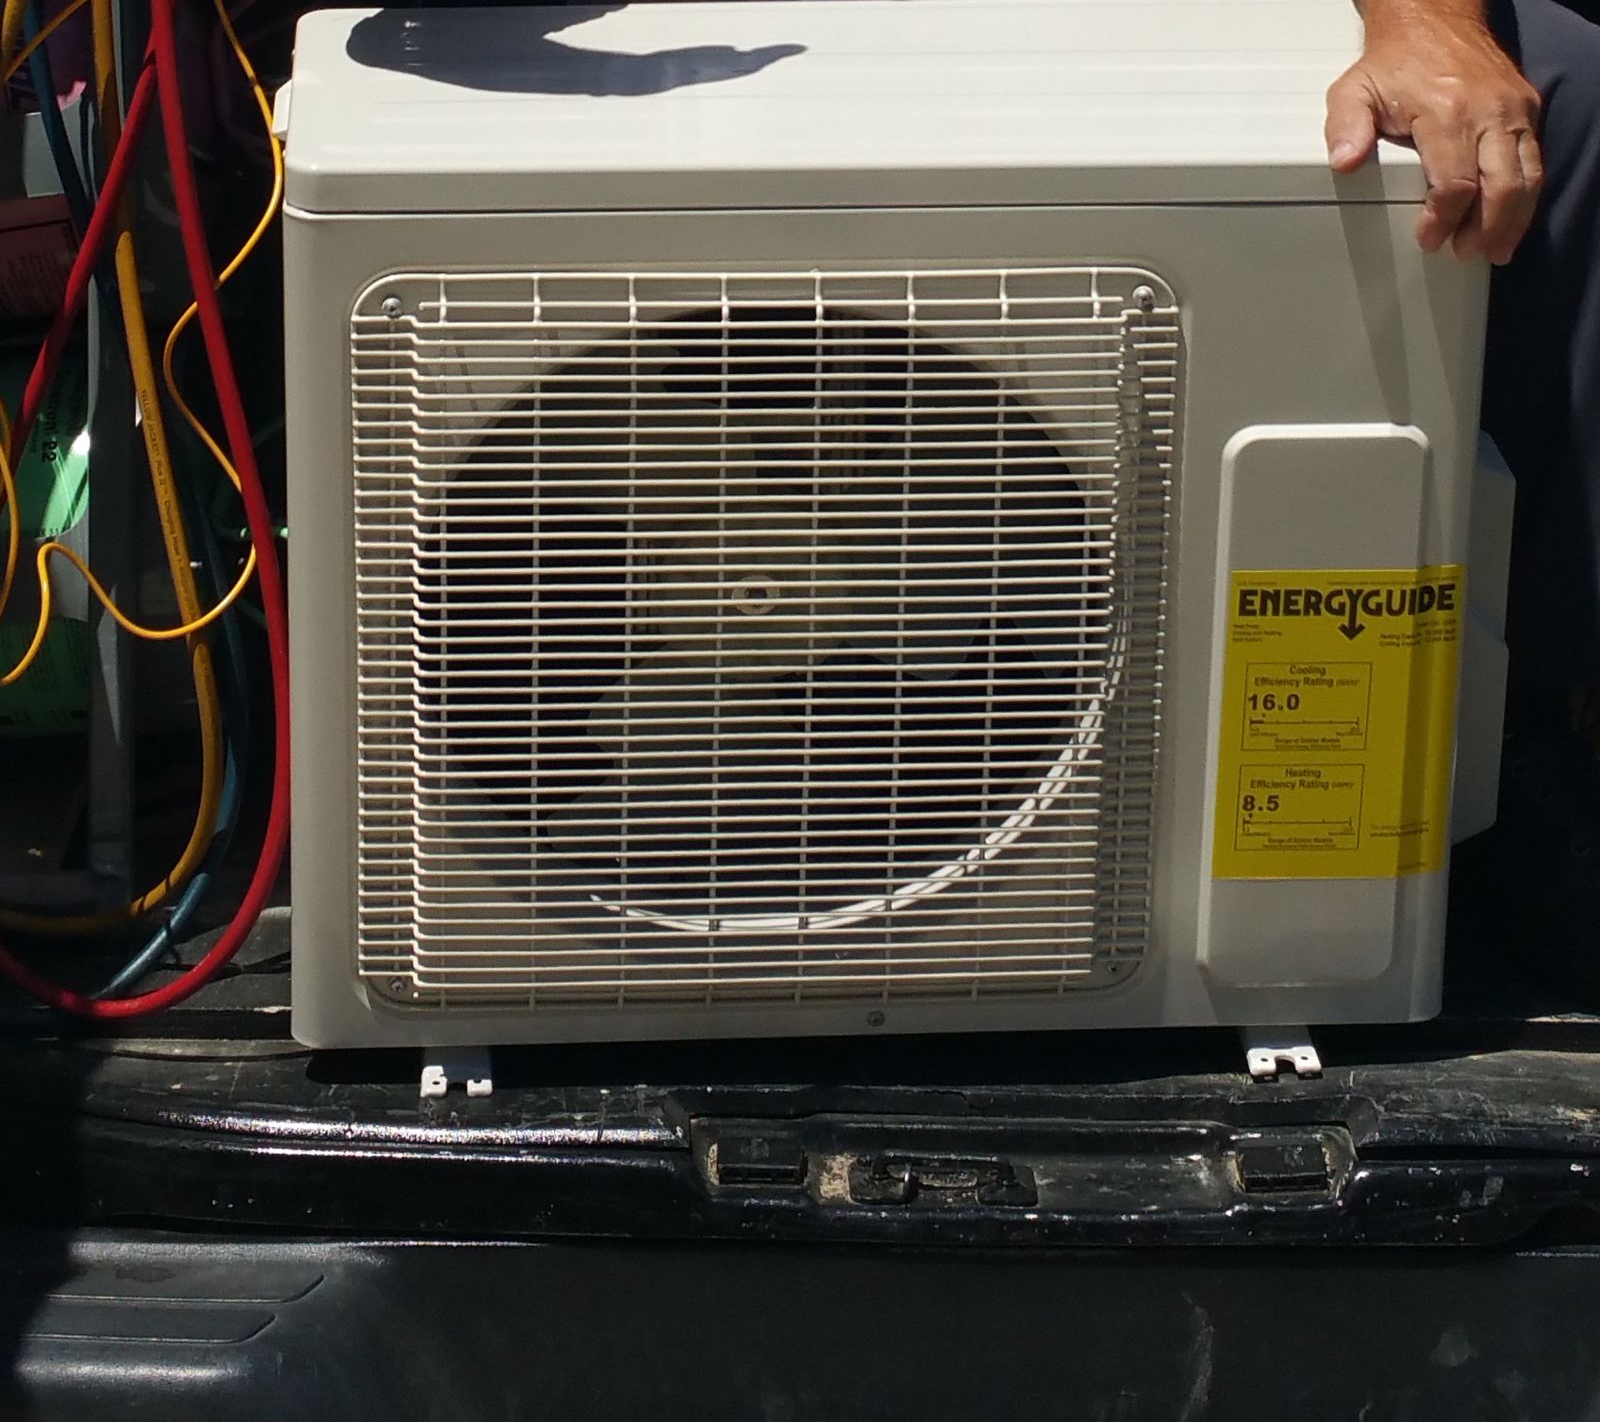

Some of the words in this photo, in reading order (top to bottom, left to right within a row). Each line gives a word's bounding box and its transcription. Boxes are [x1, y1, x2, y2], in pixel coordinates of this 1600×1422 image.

[1237, 583, 1456, 618] ENERGYGUIDE
[1289, 665, 1327, 676] Cooling
[1254, 676, 1300, 688] Efficiency
[1303, 676, 1334, 688] Rating
[1247, 693, 1300, 711] 16.0
[1285, 768, 1322, 779] Heating
[1250, 780, 1296, 790] Efficiency
[1298, 779, 1330, 791] Rating
[1242, 794, 1280, 812] 8.5
